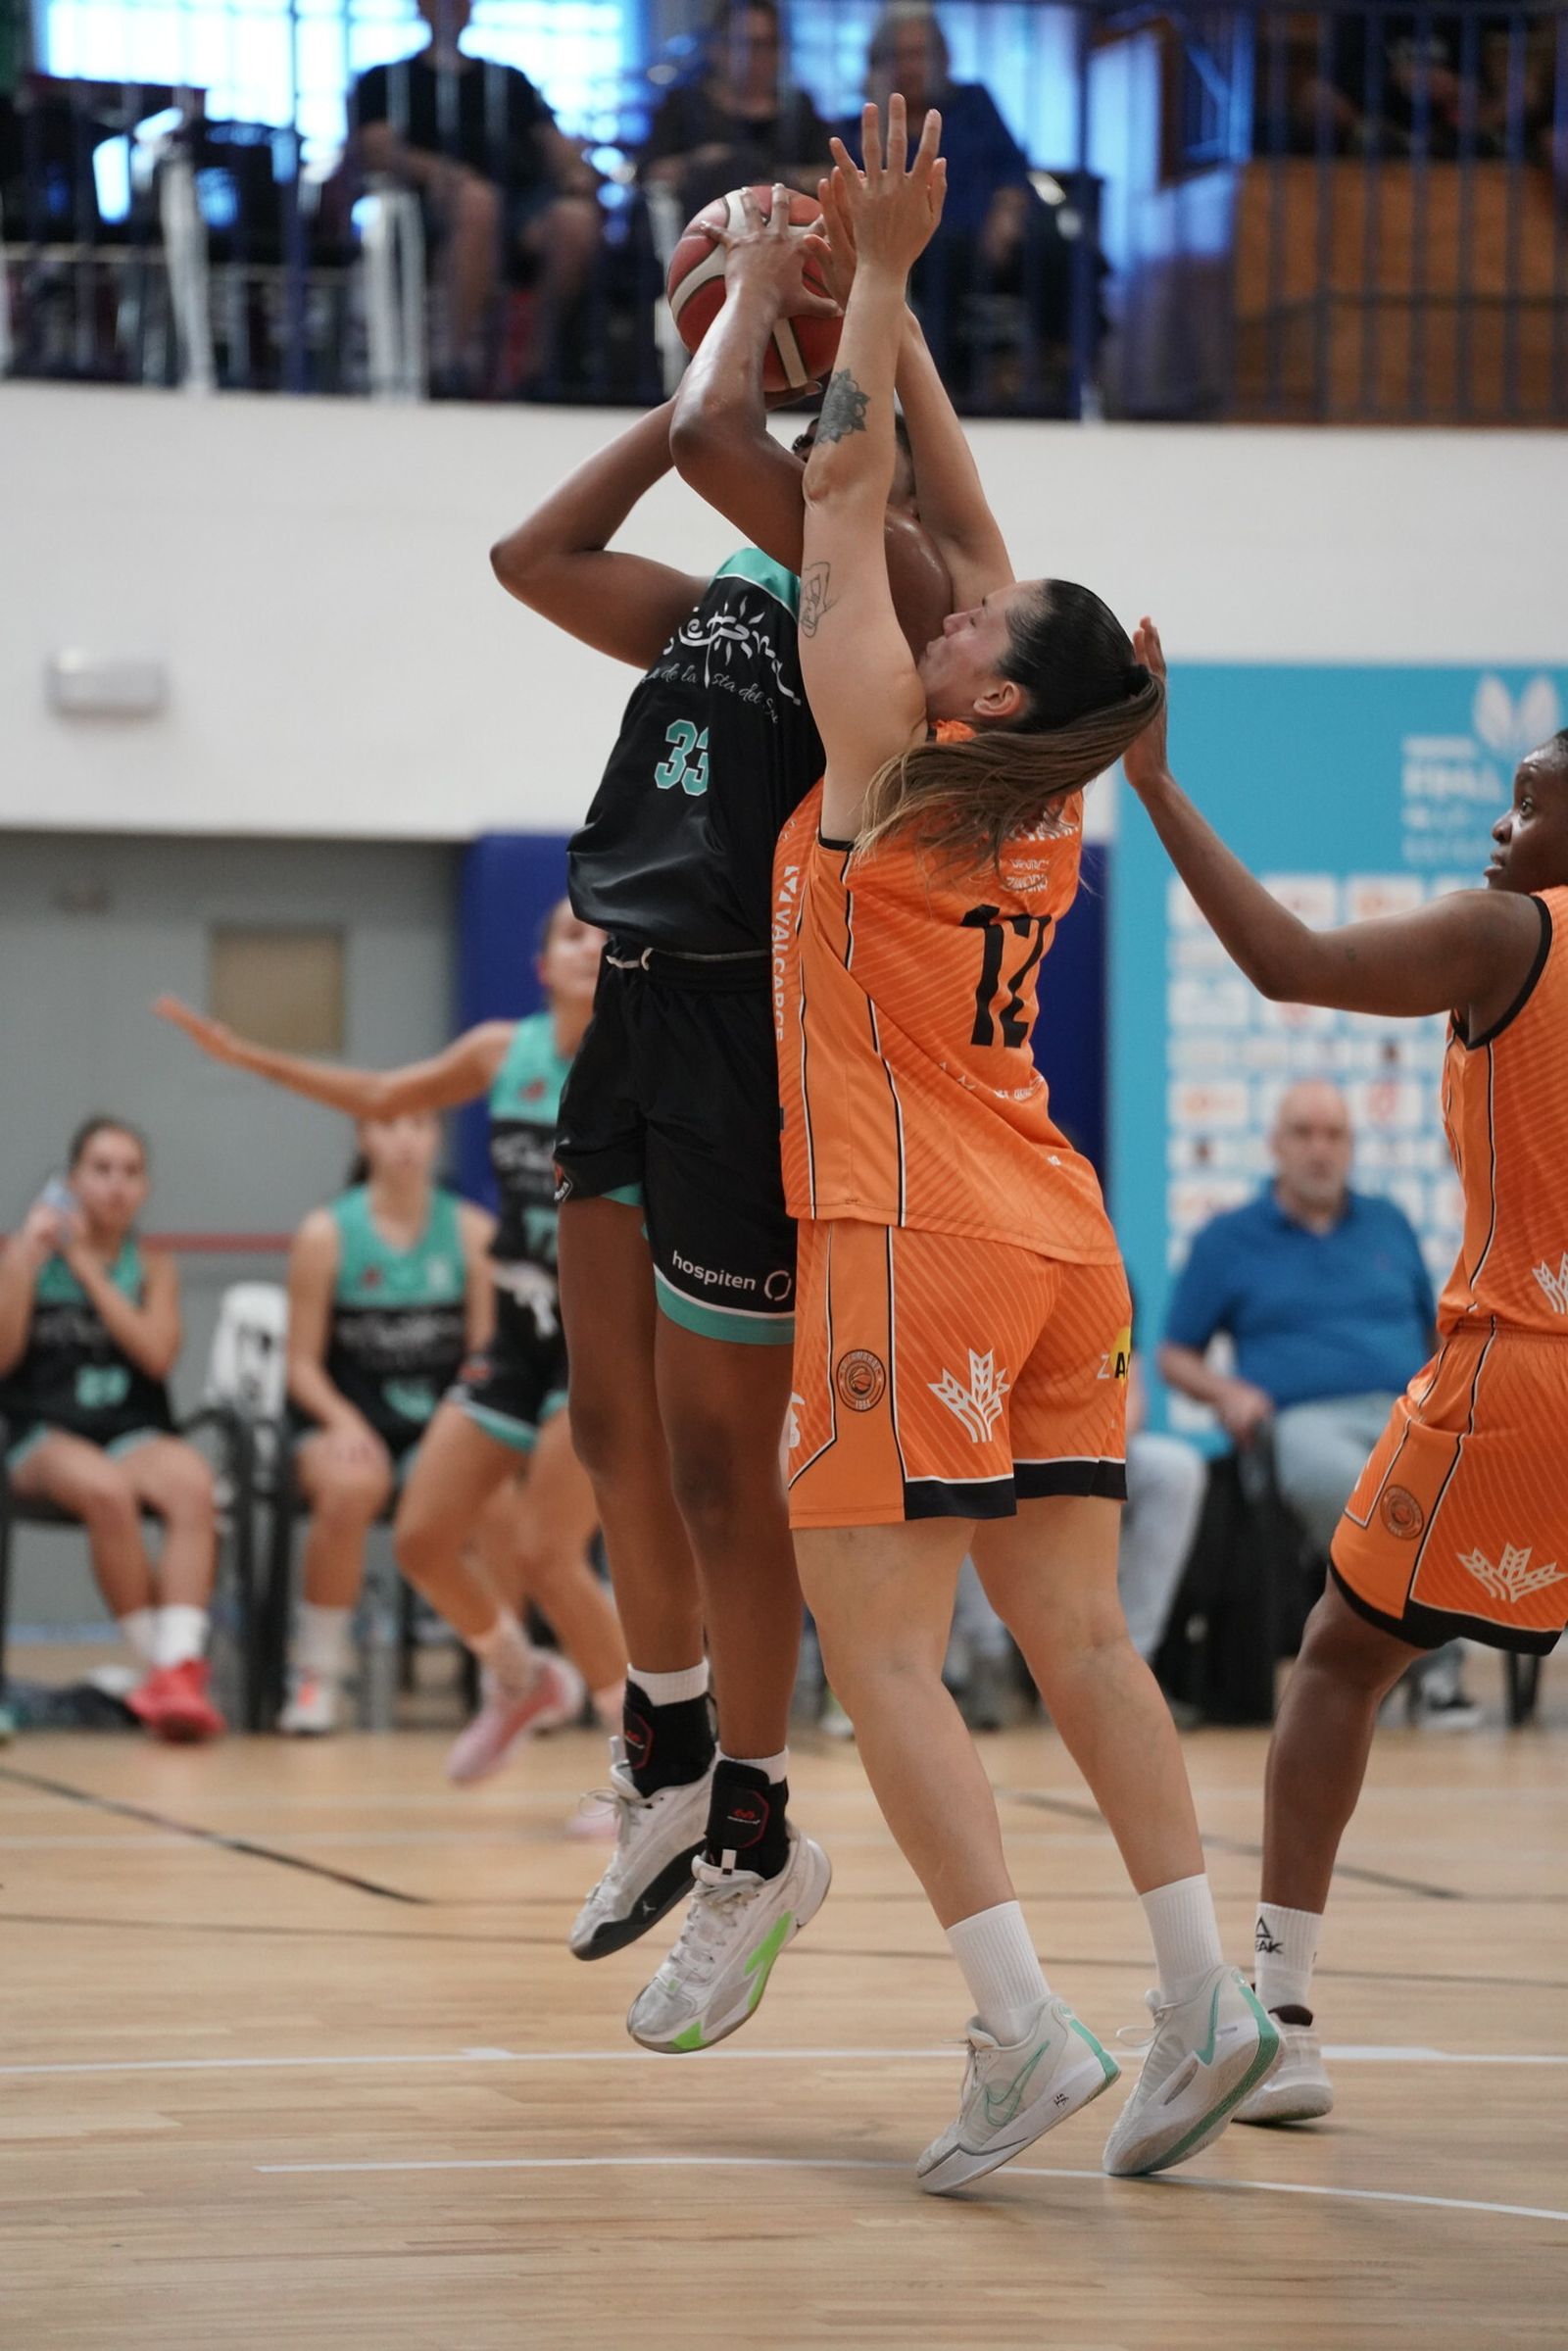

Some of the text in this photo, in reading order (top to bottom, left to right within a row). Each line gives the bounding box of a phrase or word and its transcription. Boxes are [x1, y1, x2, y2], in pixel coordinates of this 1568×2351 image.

[960, 904, 1052, 1049] 12
[671, 1249, 758, 1292] hospiten
[1097, 1351, 1130, 1380] ZA
